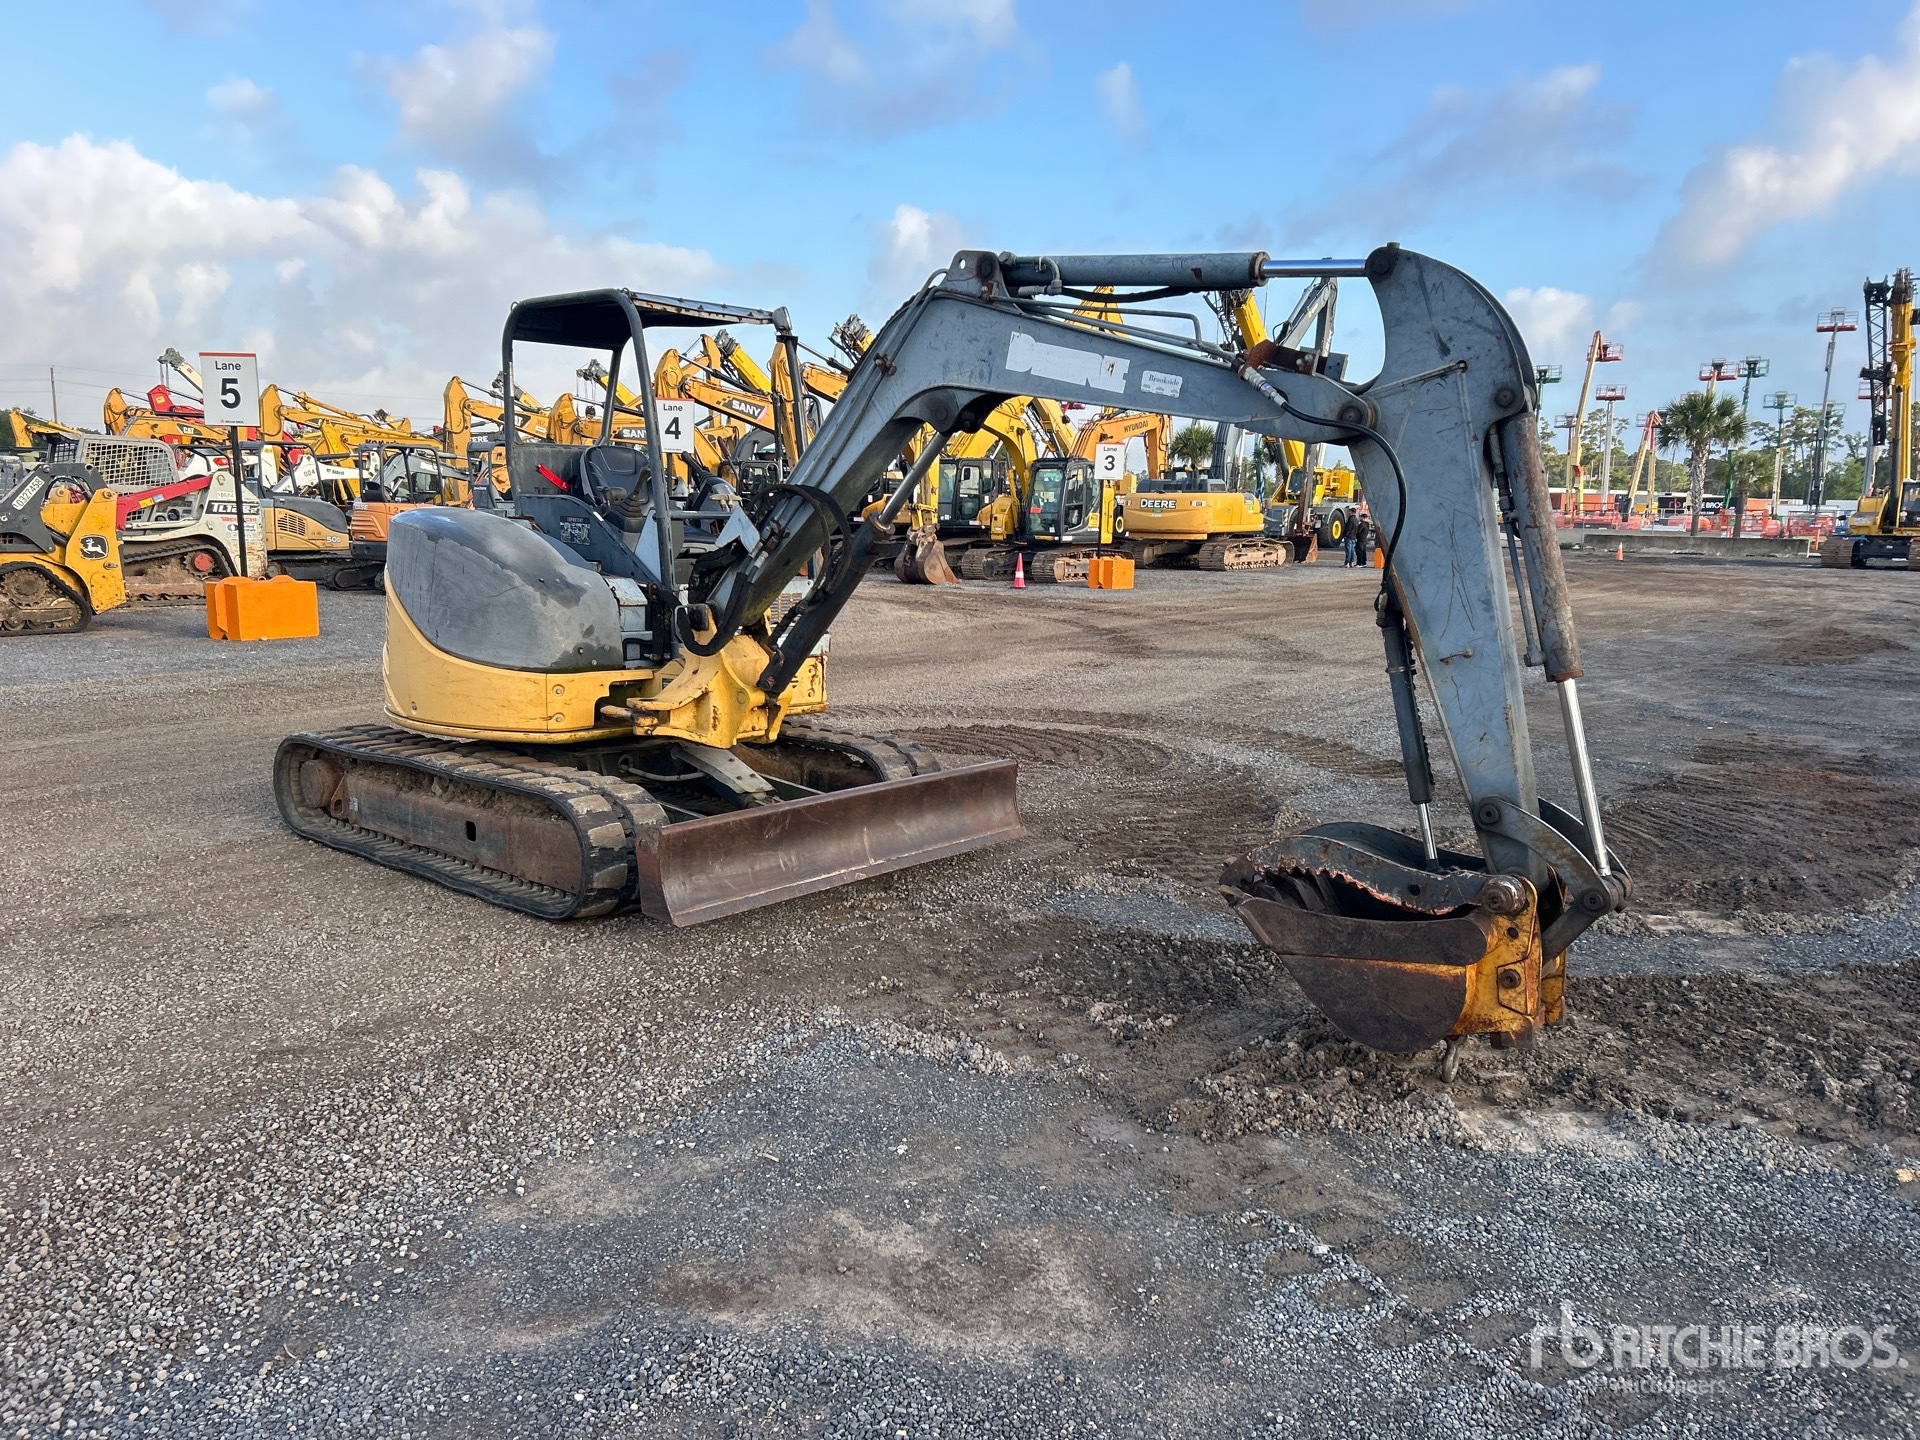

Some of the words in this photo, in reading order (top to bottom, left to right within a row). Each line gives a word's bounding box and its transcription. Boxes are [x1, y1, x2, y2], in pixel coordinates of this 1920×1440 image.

[215, 360, 242, 371] Lane
[1148, 374, 1180, 387] Brookside
[220, 377, 241, 409] 5
[663, 403, 683, 412] Lane
[731, 400, 761, 417] SANY
[183, 426, 195, 435] CAT
[664, 416, 682, 440] 4
[1123, 420, 1149, 433] HYUNDAI
[469, 435, 489, 443] ERE
[1103, 454, 1116, 471] 3
[12, 477, 43, 509] 10327458
[1140, 498, 1177, 509] DEERE
